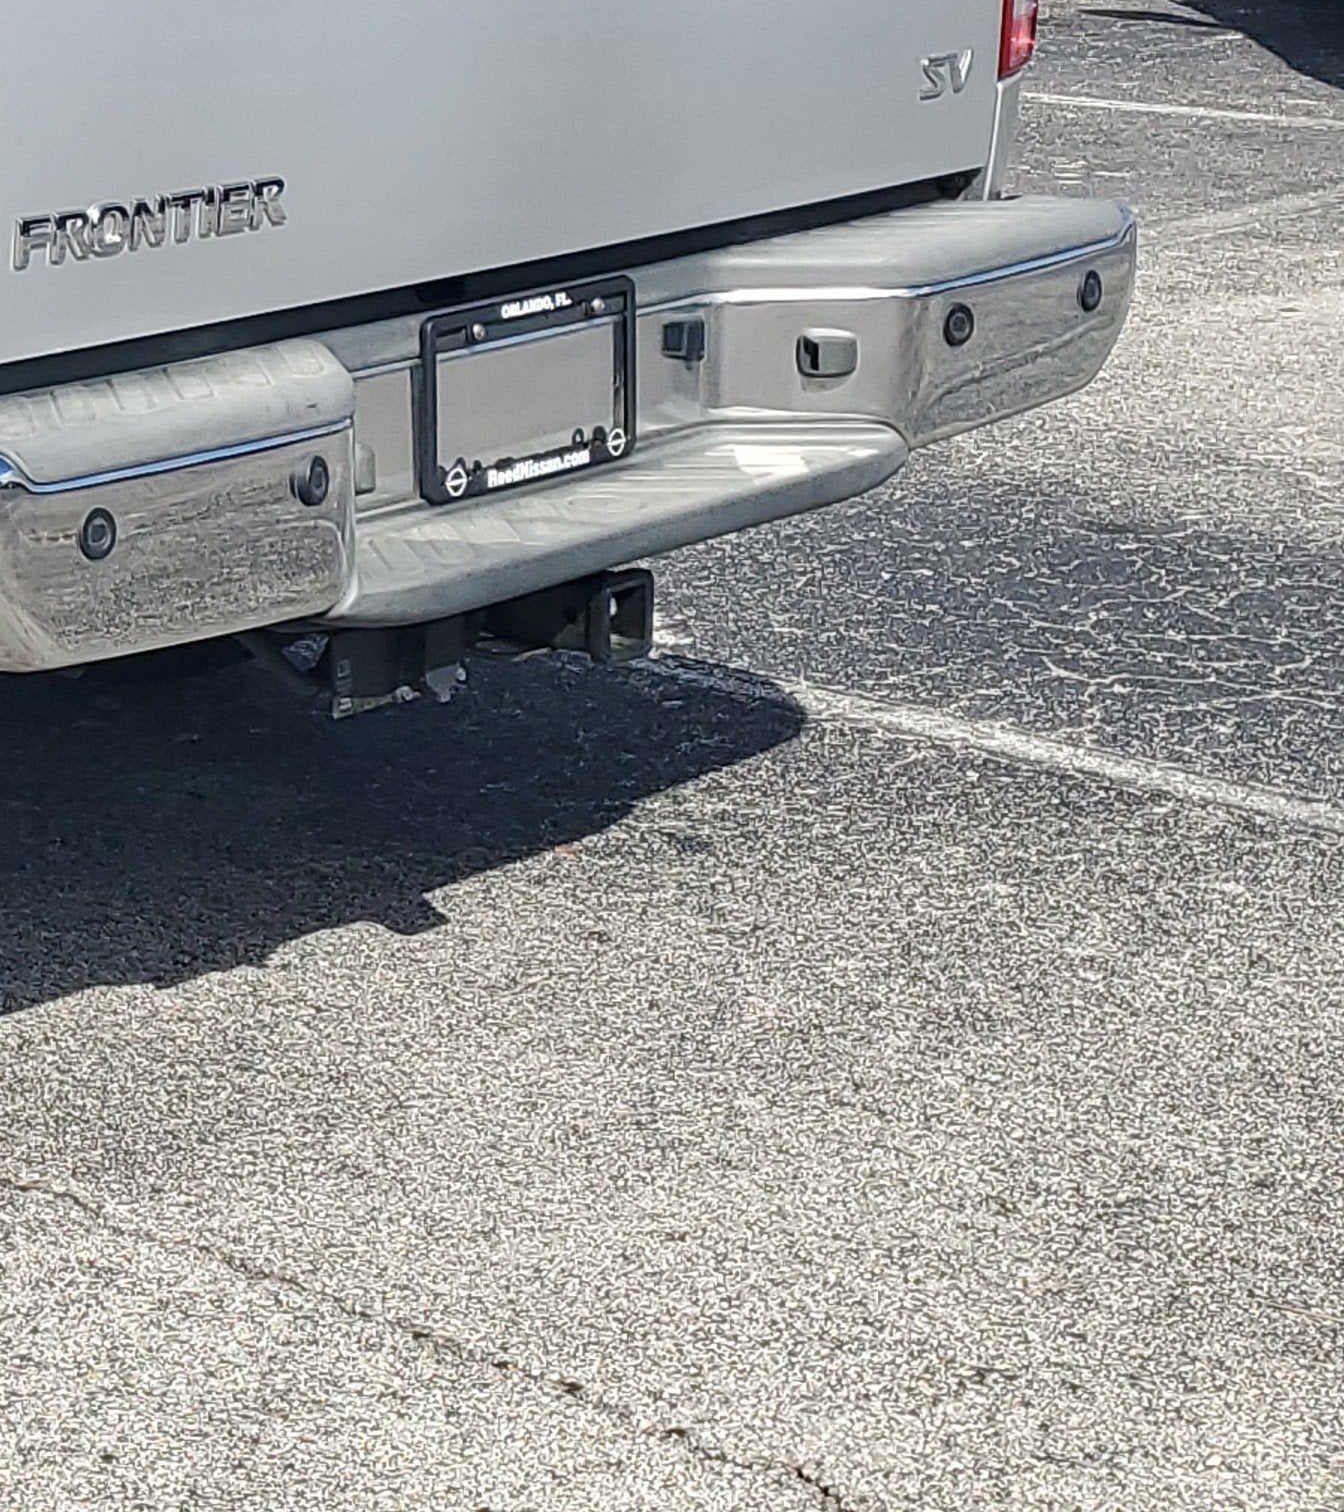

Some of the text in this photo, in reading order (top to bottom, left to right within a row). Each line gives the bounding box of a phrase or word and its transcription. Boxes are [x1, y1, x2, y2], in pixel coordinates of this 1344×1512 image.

[918, 46, 975, 102] SV
[11, 174, 288, 272] FRONTIER
[486, 449, 591, 488] ReedNissan.com
